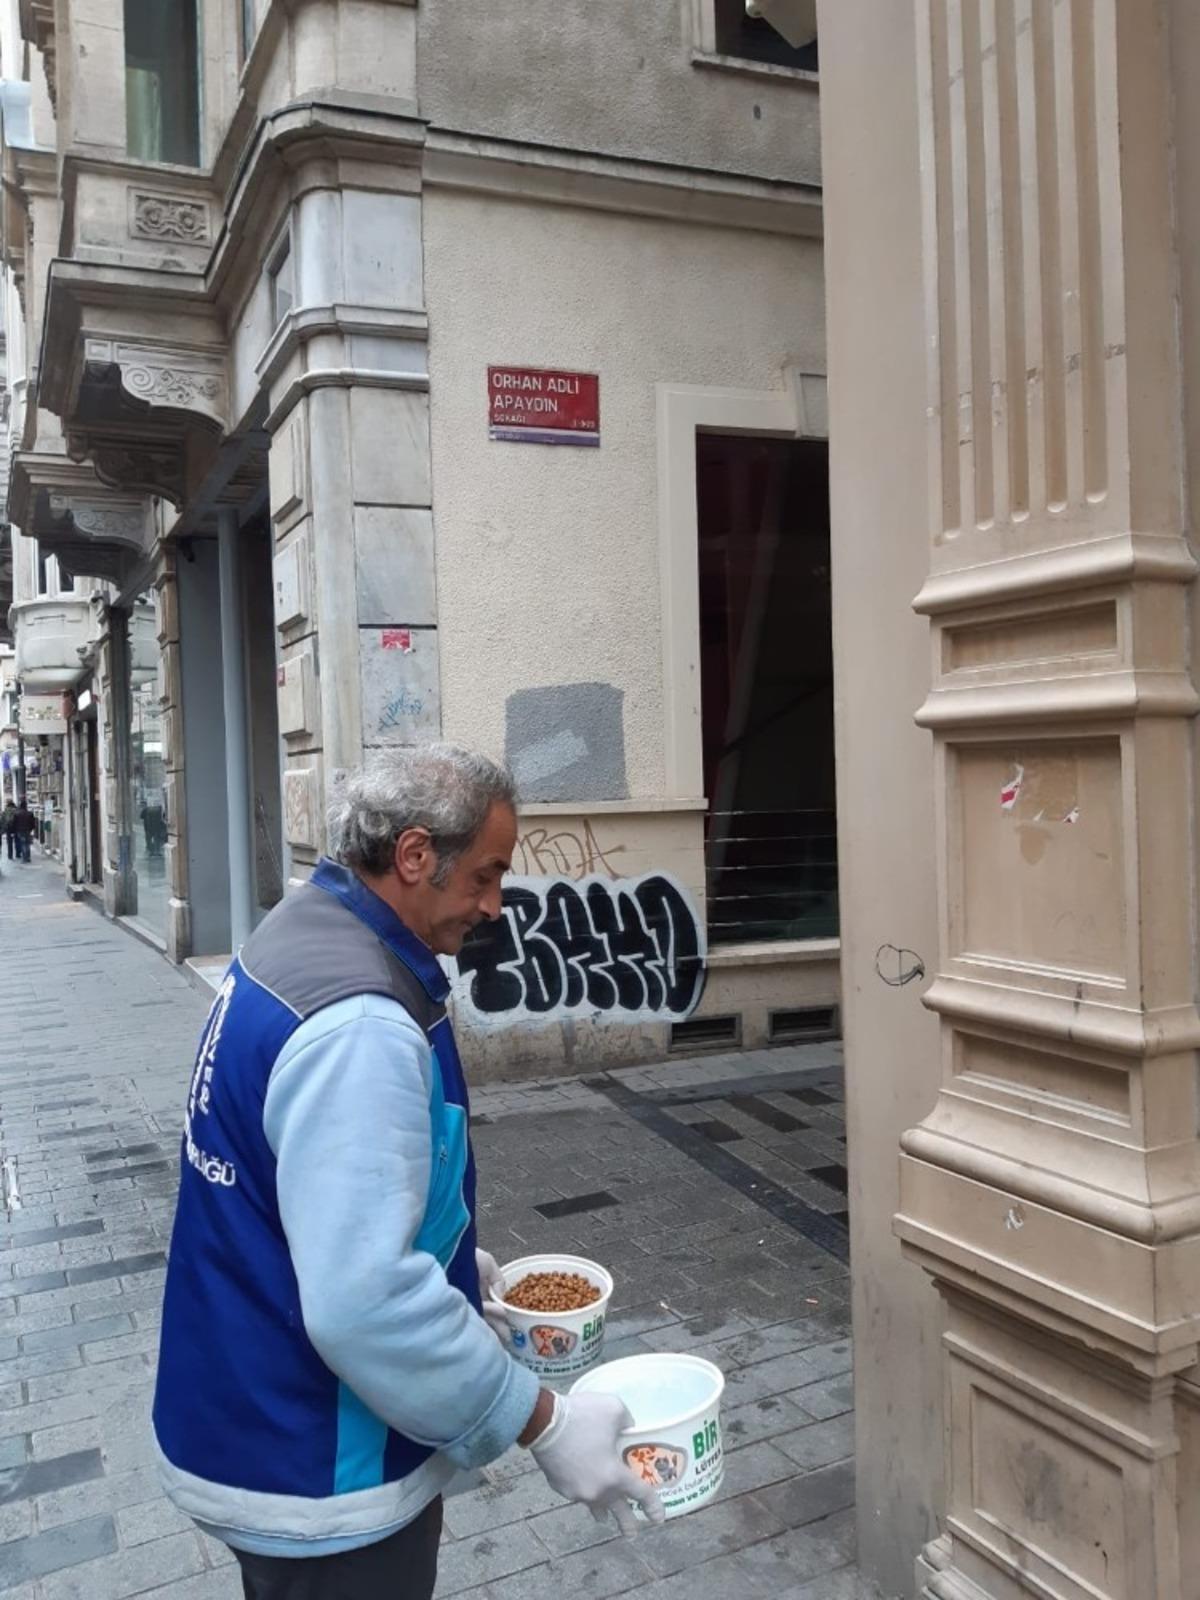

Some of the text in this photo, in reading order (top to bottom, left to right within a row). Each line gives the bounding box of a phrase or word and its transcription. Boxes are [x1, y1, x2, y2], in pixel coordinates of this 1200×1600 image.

[492, 373, 580, 395] ORHAN ADLİ
[582, 1314, 603, 1341] BİR
[692, 1420, 718, 1459] BİR
